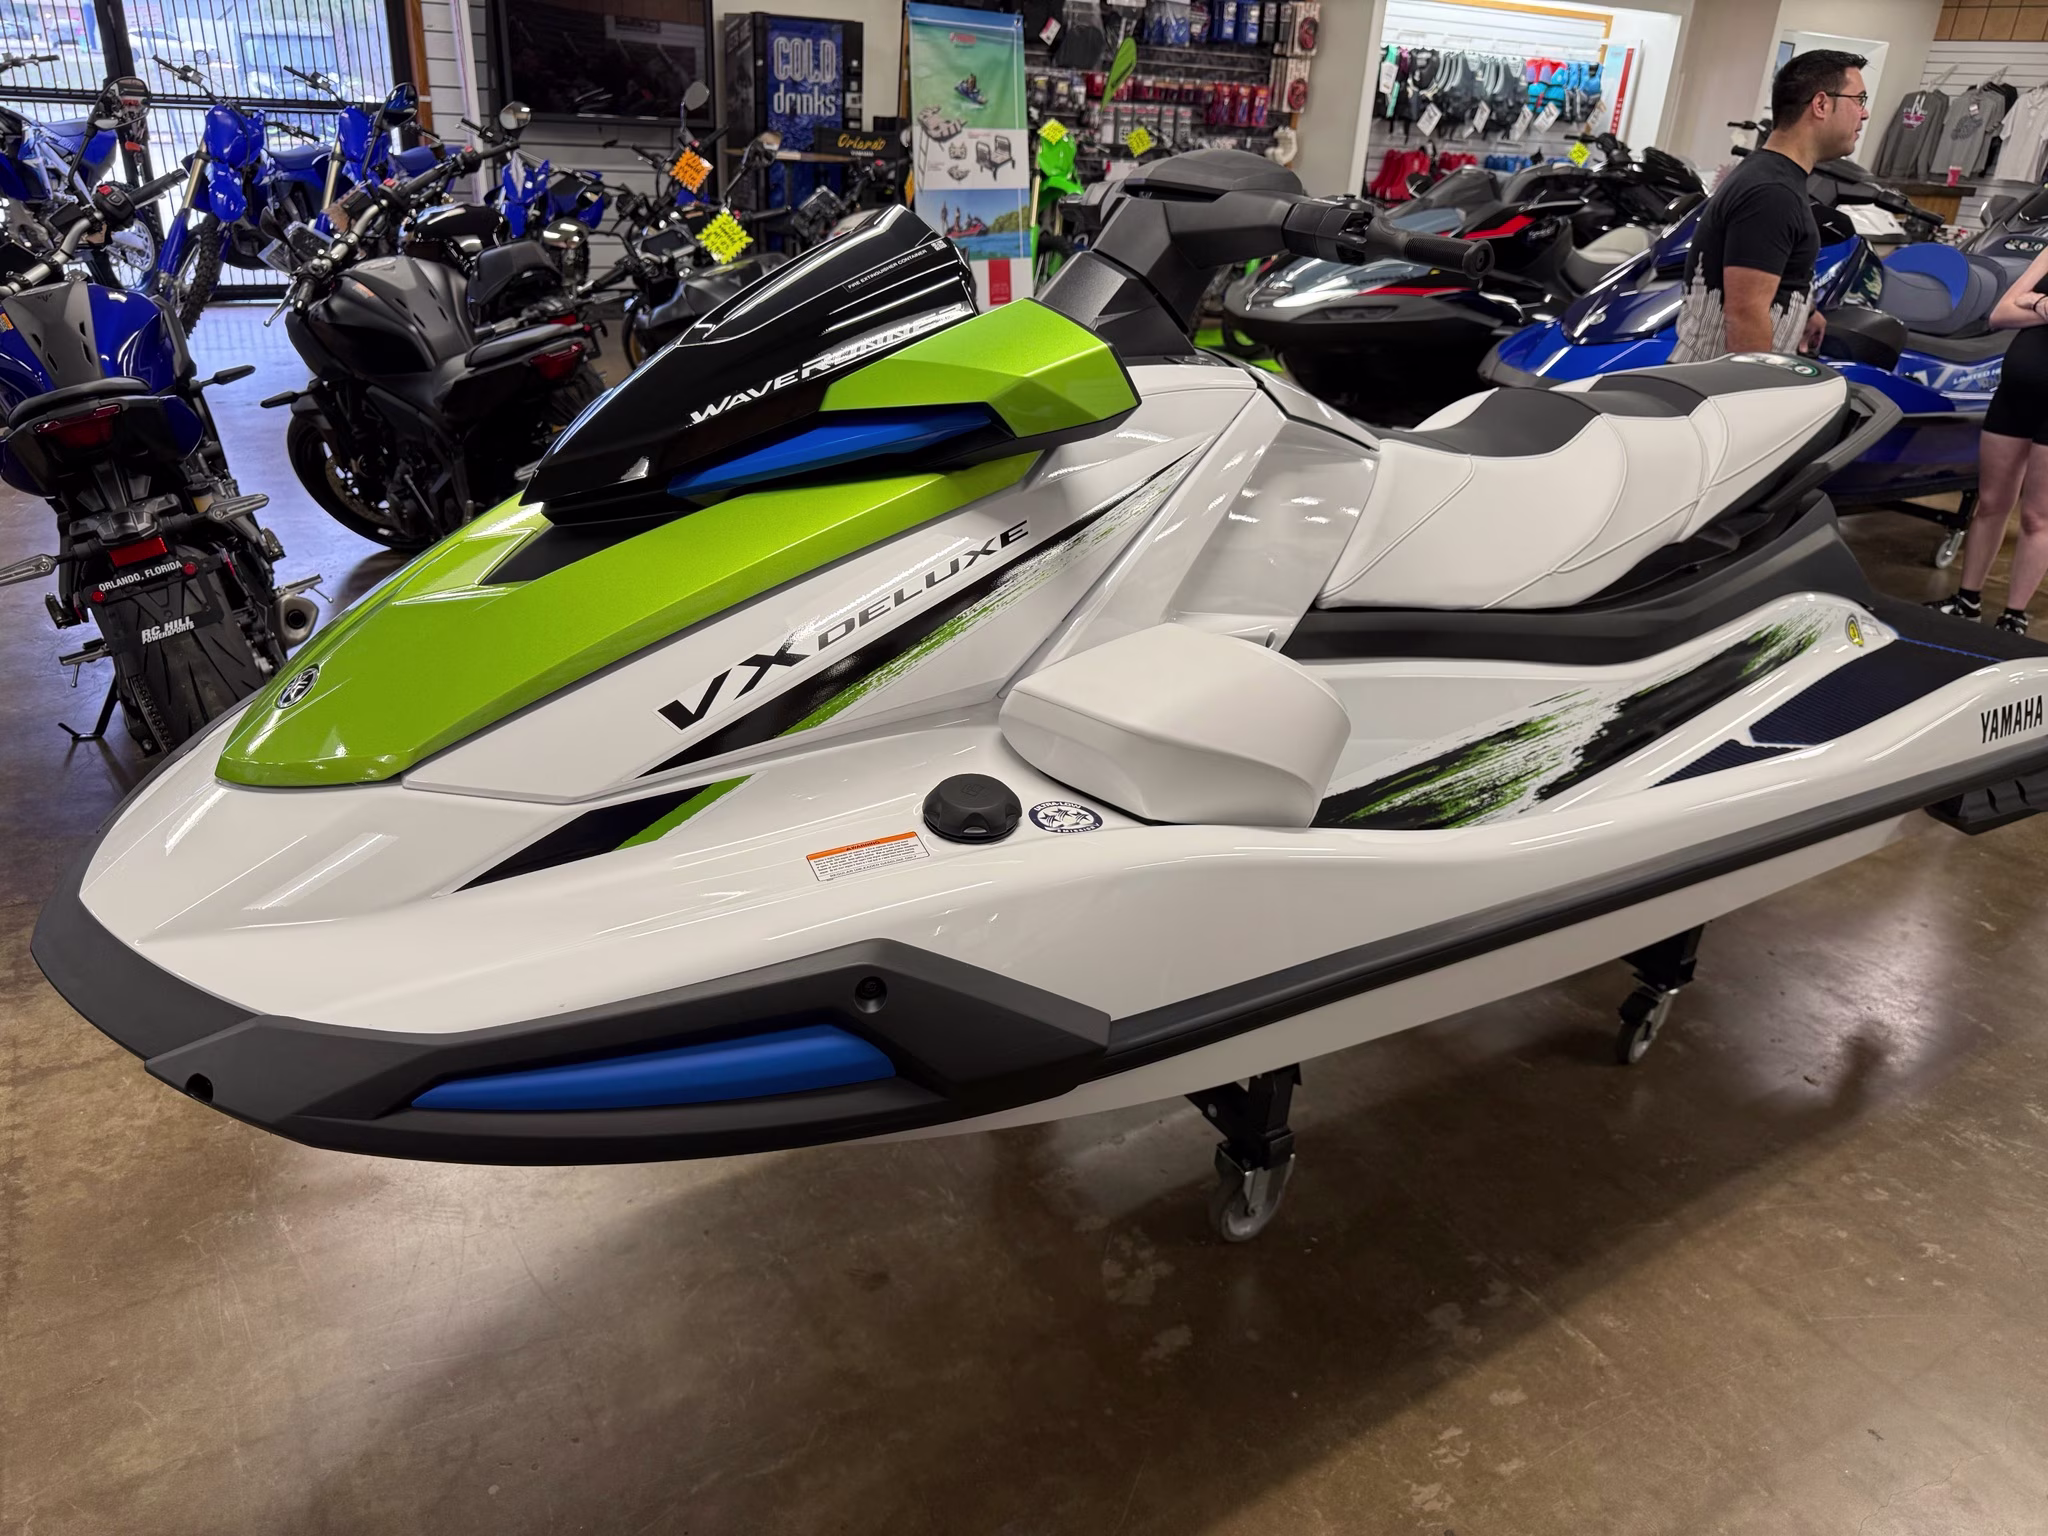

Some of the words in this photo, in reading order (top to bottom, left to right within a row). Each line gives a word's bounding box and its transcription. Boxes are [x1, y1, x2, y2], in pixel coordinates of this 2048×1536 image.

[774, 37, 836, 83] COLD
[774, 83, 836, 117] drinks
[847, 280, 861, 290] FIRE
[861, 263, 898, 283] EXTINGUISHER
[898, 249, 928, 265] CONTAINER
[98, 572, 145, 592] ORLANDO,
[144, 560, 183, 578] FLORIDA
[141, 625, 161, 640] RC
[164, 616, 191, 632] HILL
[142, 620, 195, 645] POWERSPORTS
[657, 630, 811, 731] VX
[818, 519, 1029, 652] DELUXE
[1980, 694, 2043, 744] YAMAHA
